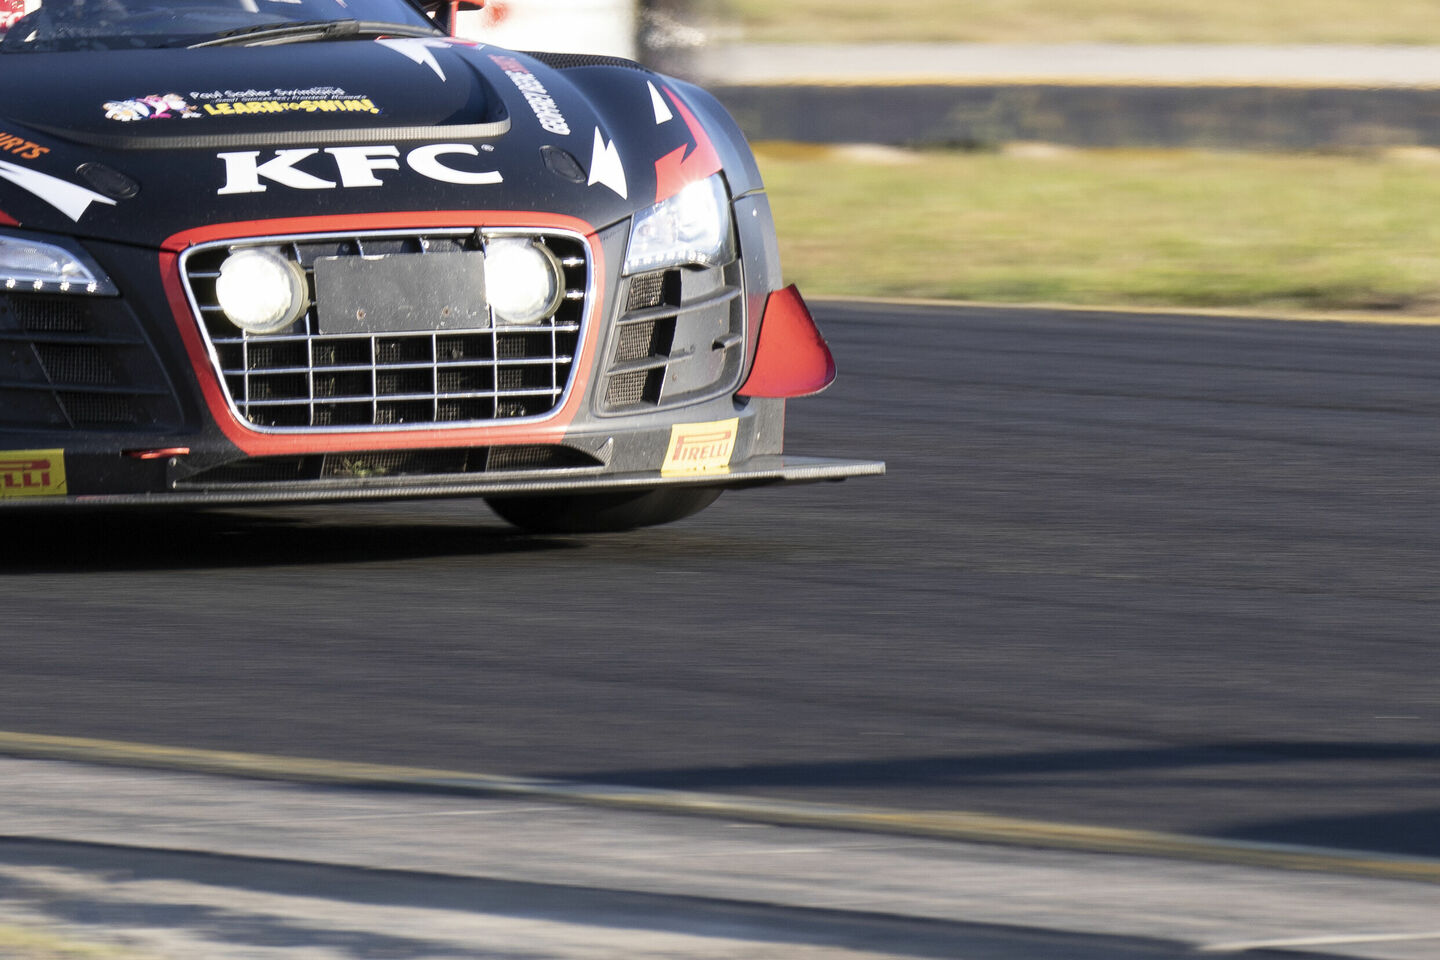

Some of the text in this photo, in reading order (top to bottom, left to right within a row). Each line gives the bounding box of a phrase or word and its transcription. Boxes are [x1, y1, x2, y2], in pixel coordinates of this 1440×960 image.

[203, 100, 284, 115] LEARN
[300, 99, 380, 114] SWIM!
[216, 143, 504, 195] KFC
[672, 431, 732, 461] PIRELLI
